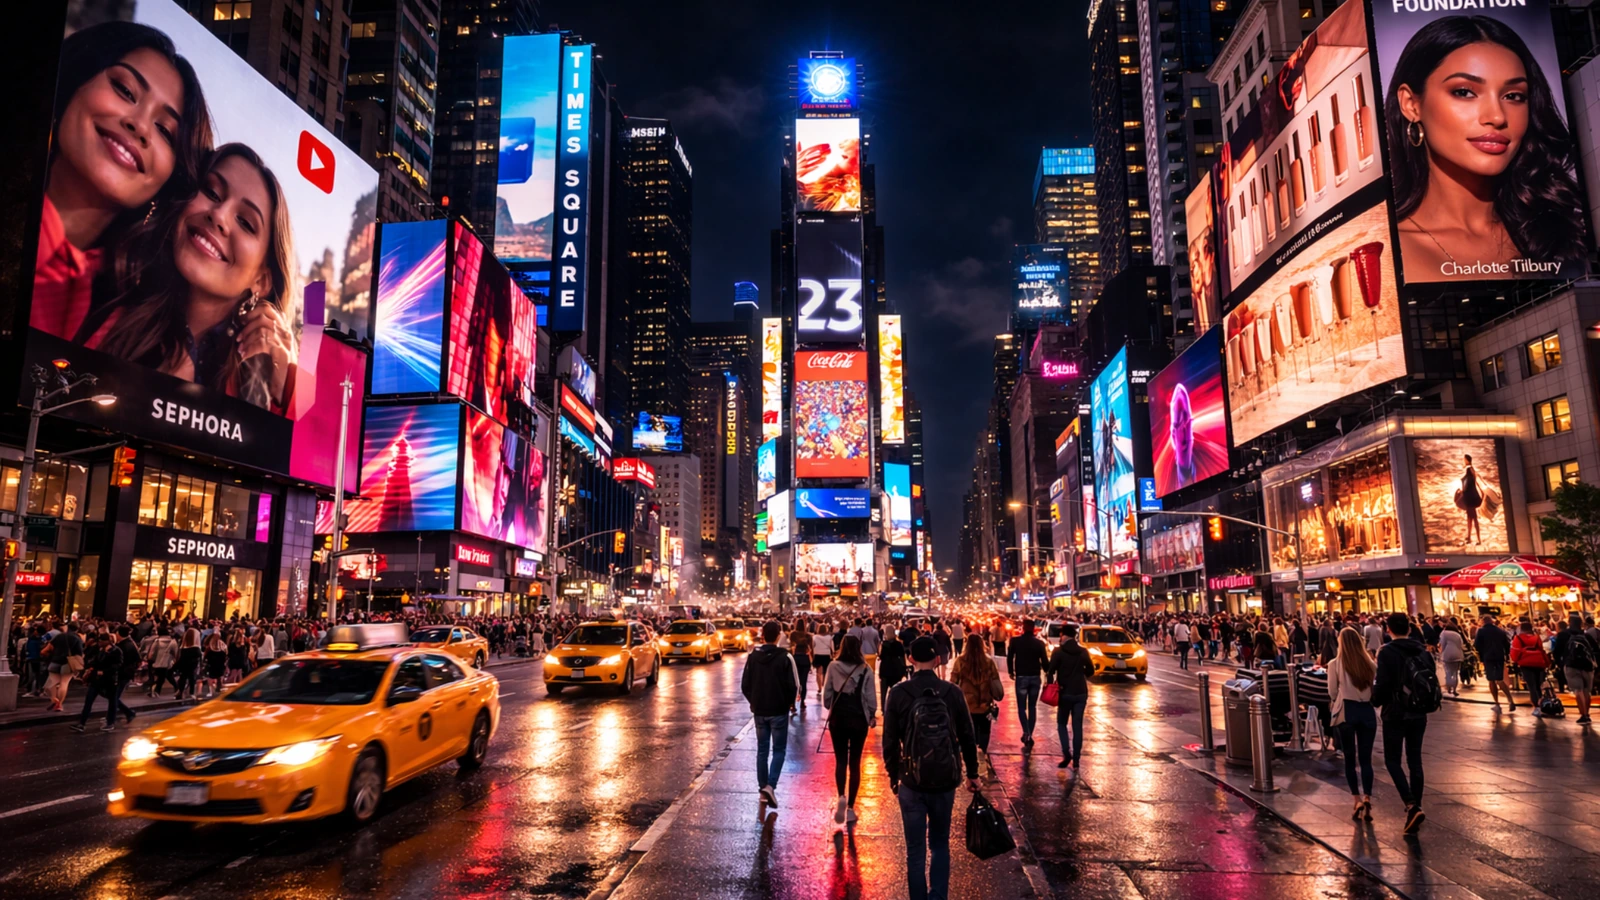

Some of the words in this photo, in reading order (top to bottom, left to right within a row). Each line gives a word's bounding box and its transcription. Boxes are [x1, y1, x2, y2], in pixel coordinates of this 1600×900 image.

[566, 52, 584, 153] TIMES
[560, 169, 581, 307] SQUARE
[1440, 260, 1509, 276] Charlotte
[1510, 258, 1562, 275] Tilbury
[798, 279, 862, 332] 23
[152, 398, 243, 442] SEPHORA
[167, 537, 236, 560] SEPHORA
